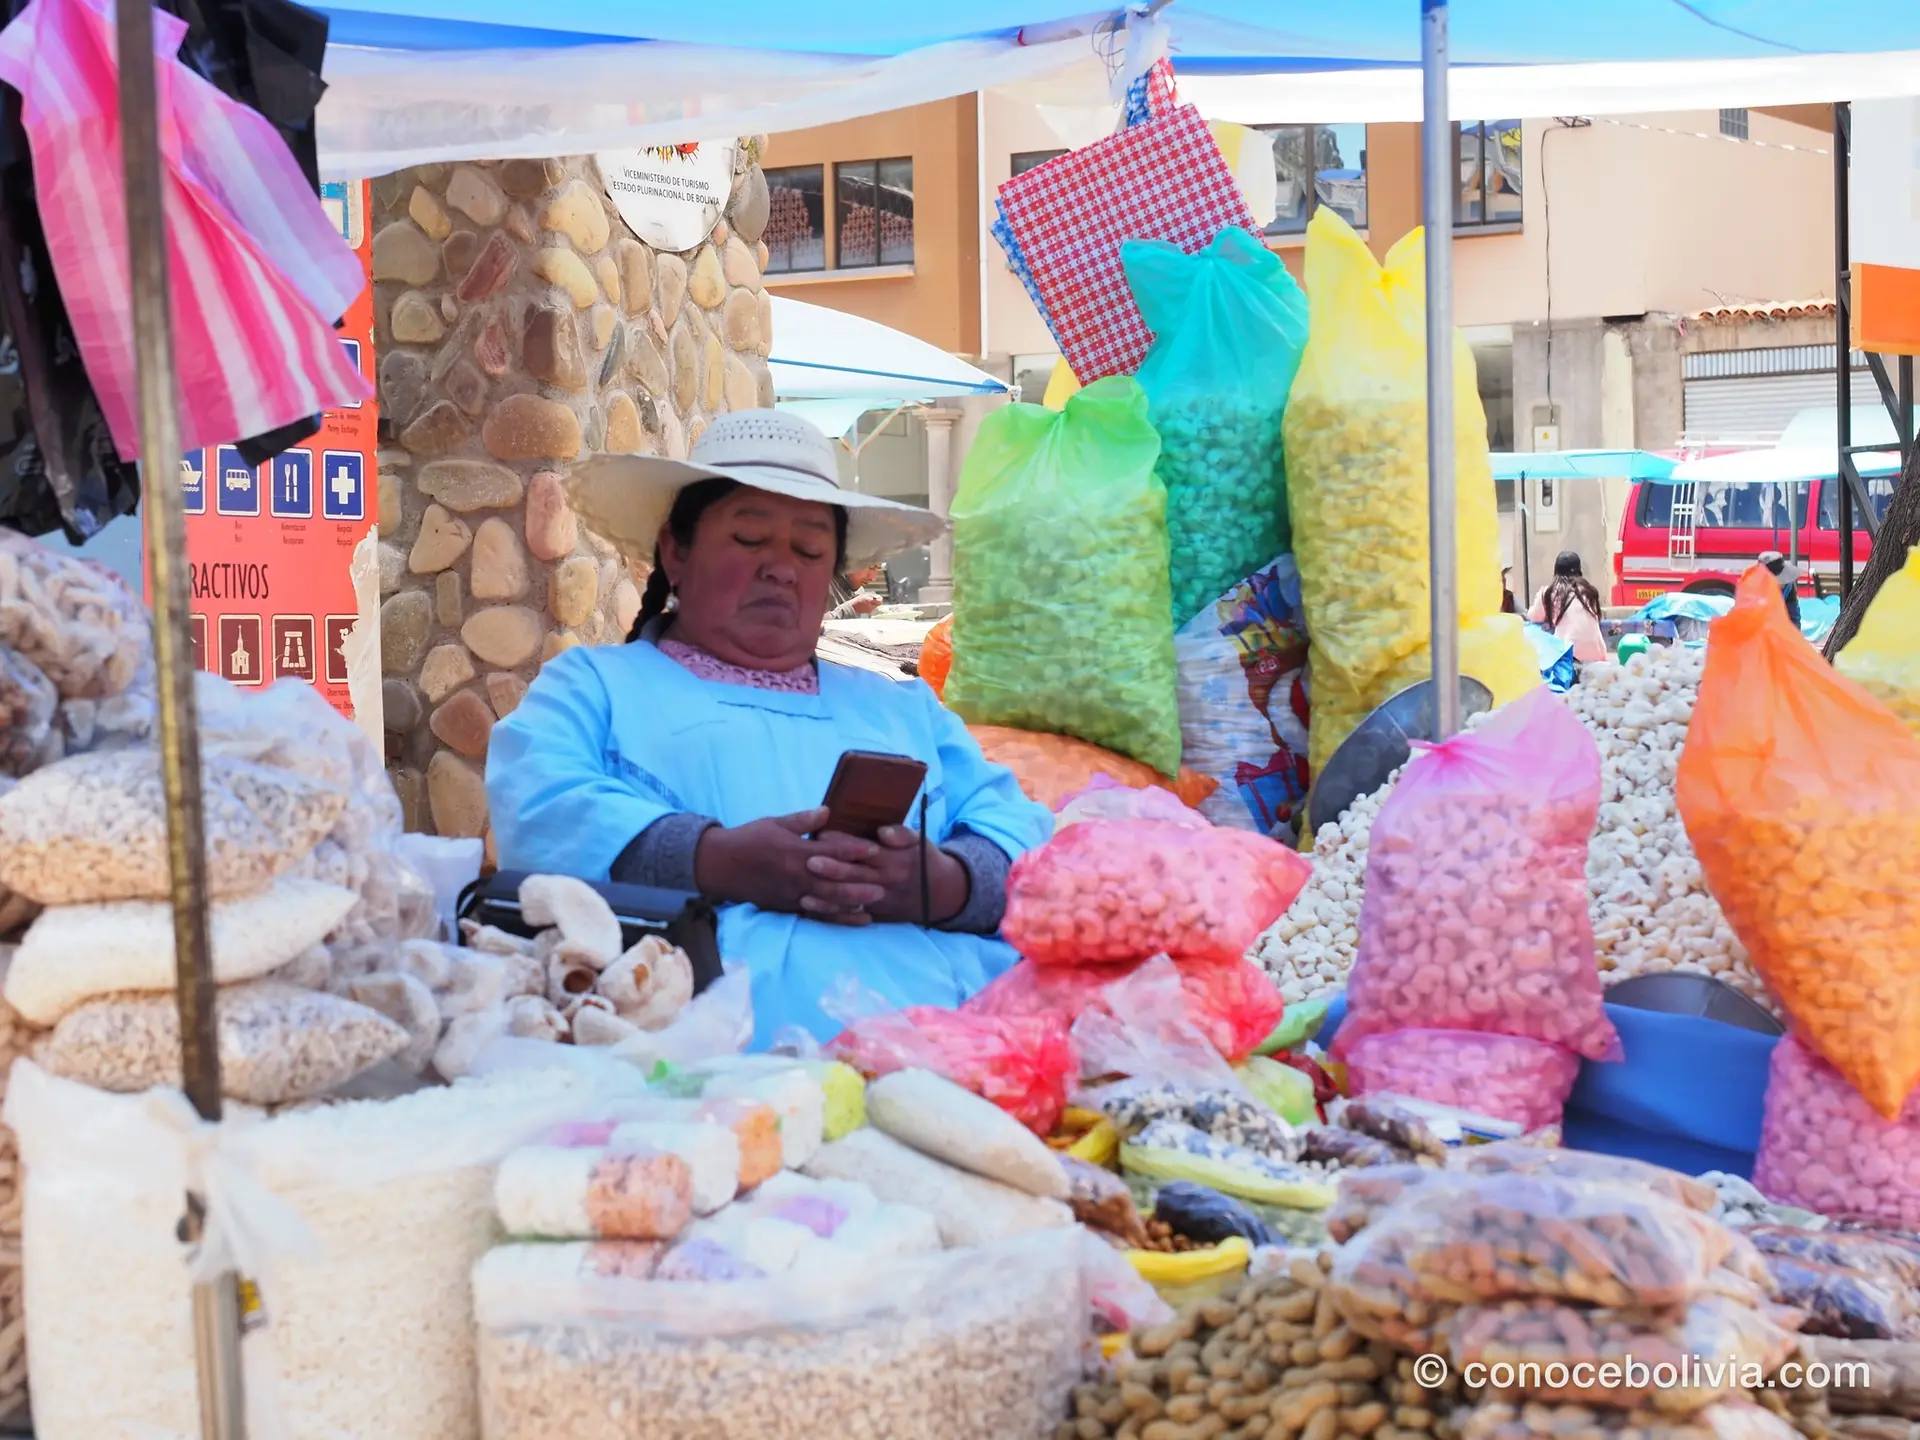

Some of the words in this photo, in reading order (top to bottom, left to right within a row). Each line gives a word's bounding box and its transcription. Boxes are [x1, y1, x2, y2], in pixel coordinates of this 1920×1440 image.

[623, 167, 671, 185] VICEMINISTERIO
[672, 176, 681, 186] DE
[682, 178, 710, 191] TURISMO
[613, 180, 637, 193] ESTADO
[637, 185, 685, 201] PLURINACIONAL
[686, 192, 695, 202] DE
[695, 194, 720, 206] BOLIVIA
[188, 562, 269, 599] RACTIVOS
